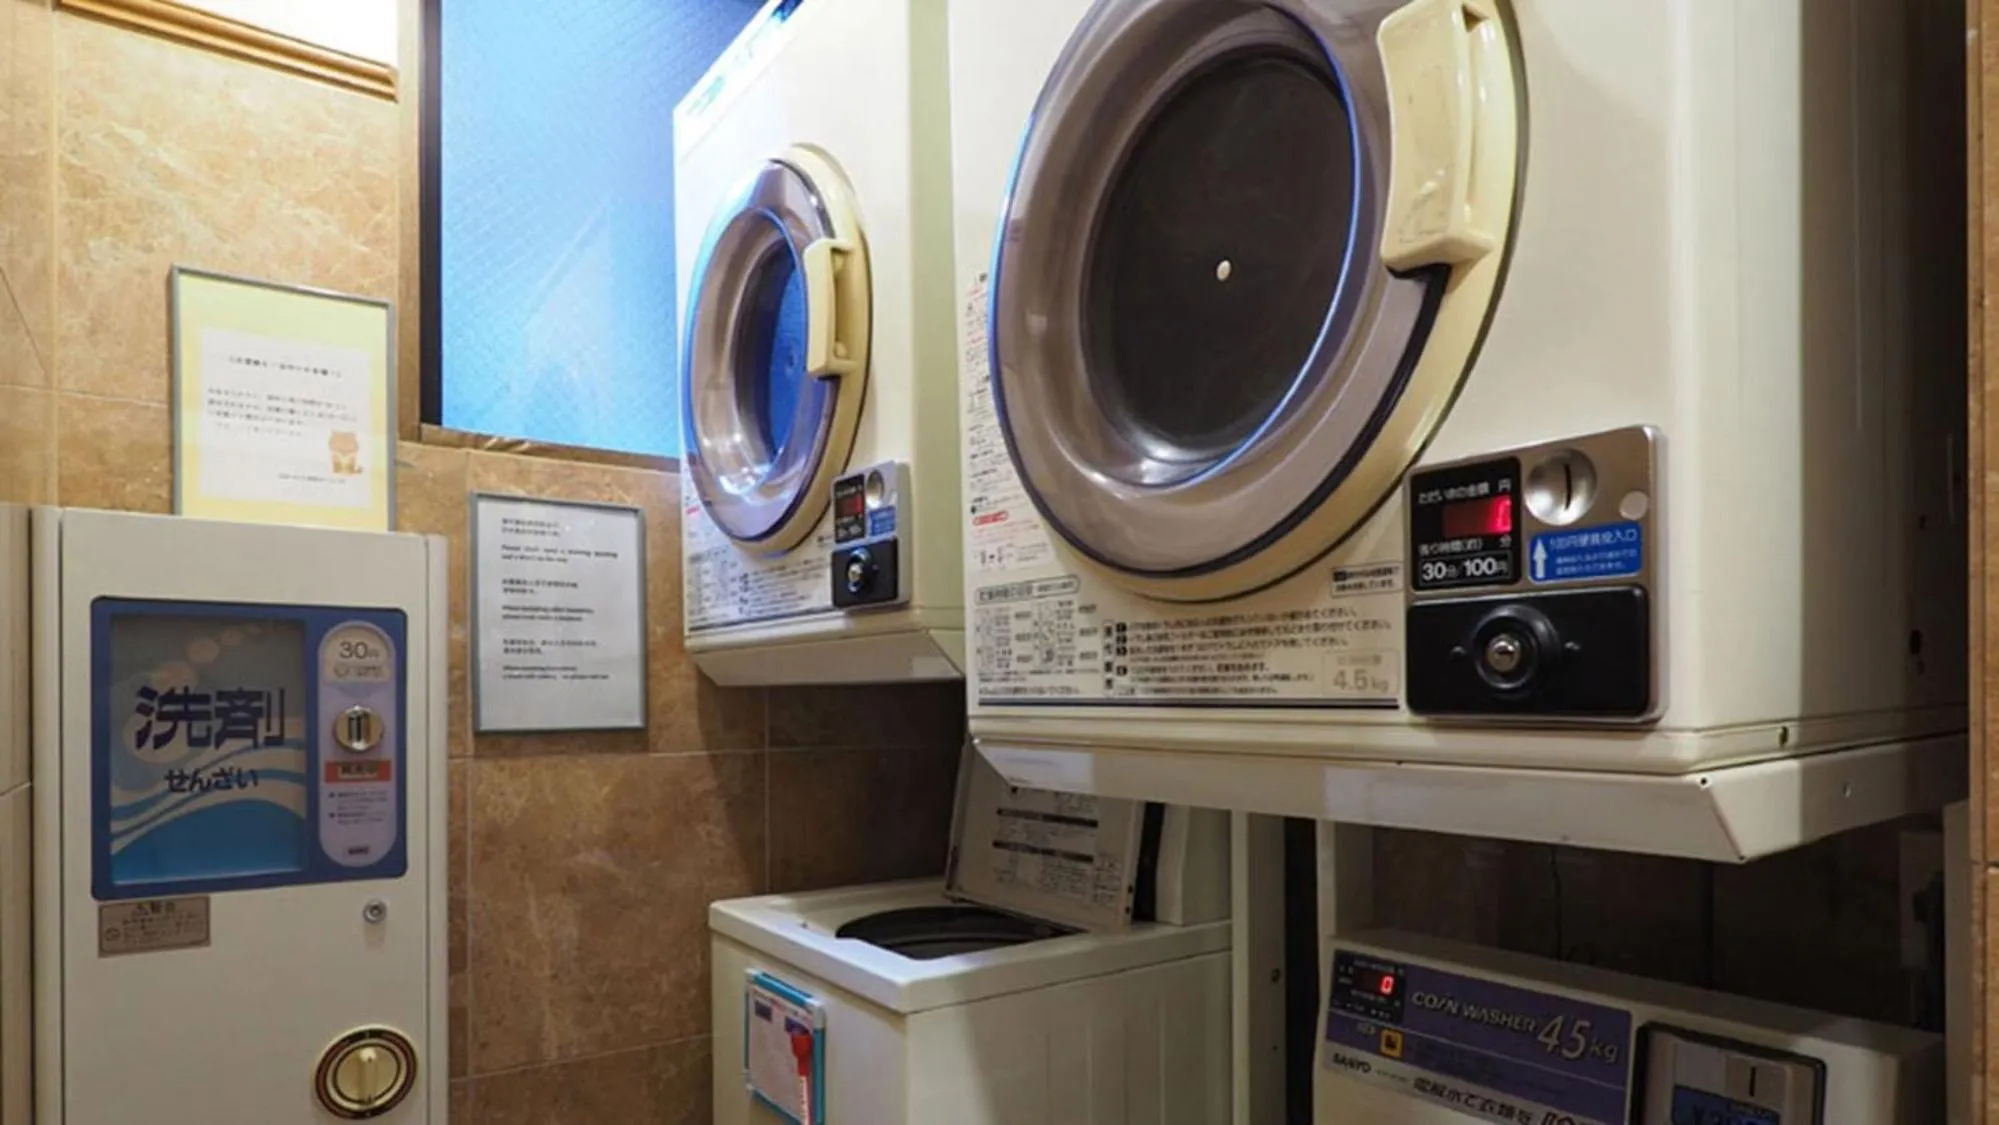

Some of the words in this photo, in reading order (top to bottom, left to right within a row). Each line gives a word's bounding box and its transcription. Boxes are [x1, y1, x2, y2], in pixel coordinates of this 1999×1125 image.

[134, 686, 286, 750] 洗剤
[164, 767, 259, 793] せんざい
[1379, 975, 1394, 995] 0
[1411, 989, 1459, 1016] COIN
[1462, 1002, 1537, 1033] WASHER
[1332, 1052, 1372, 1075] SANYO
